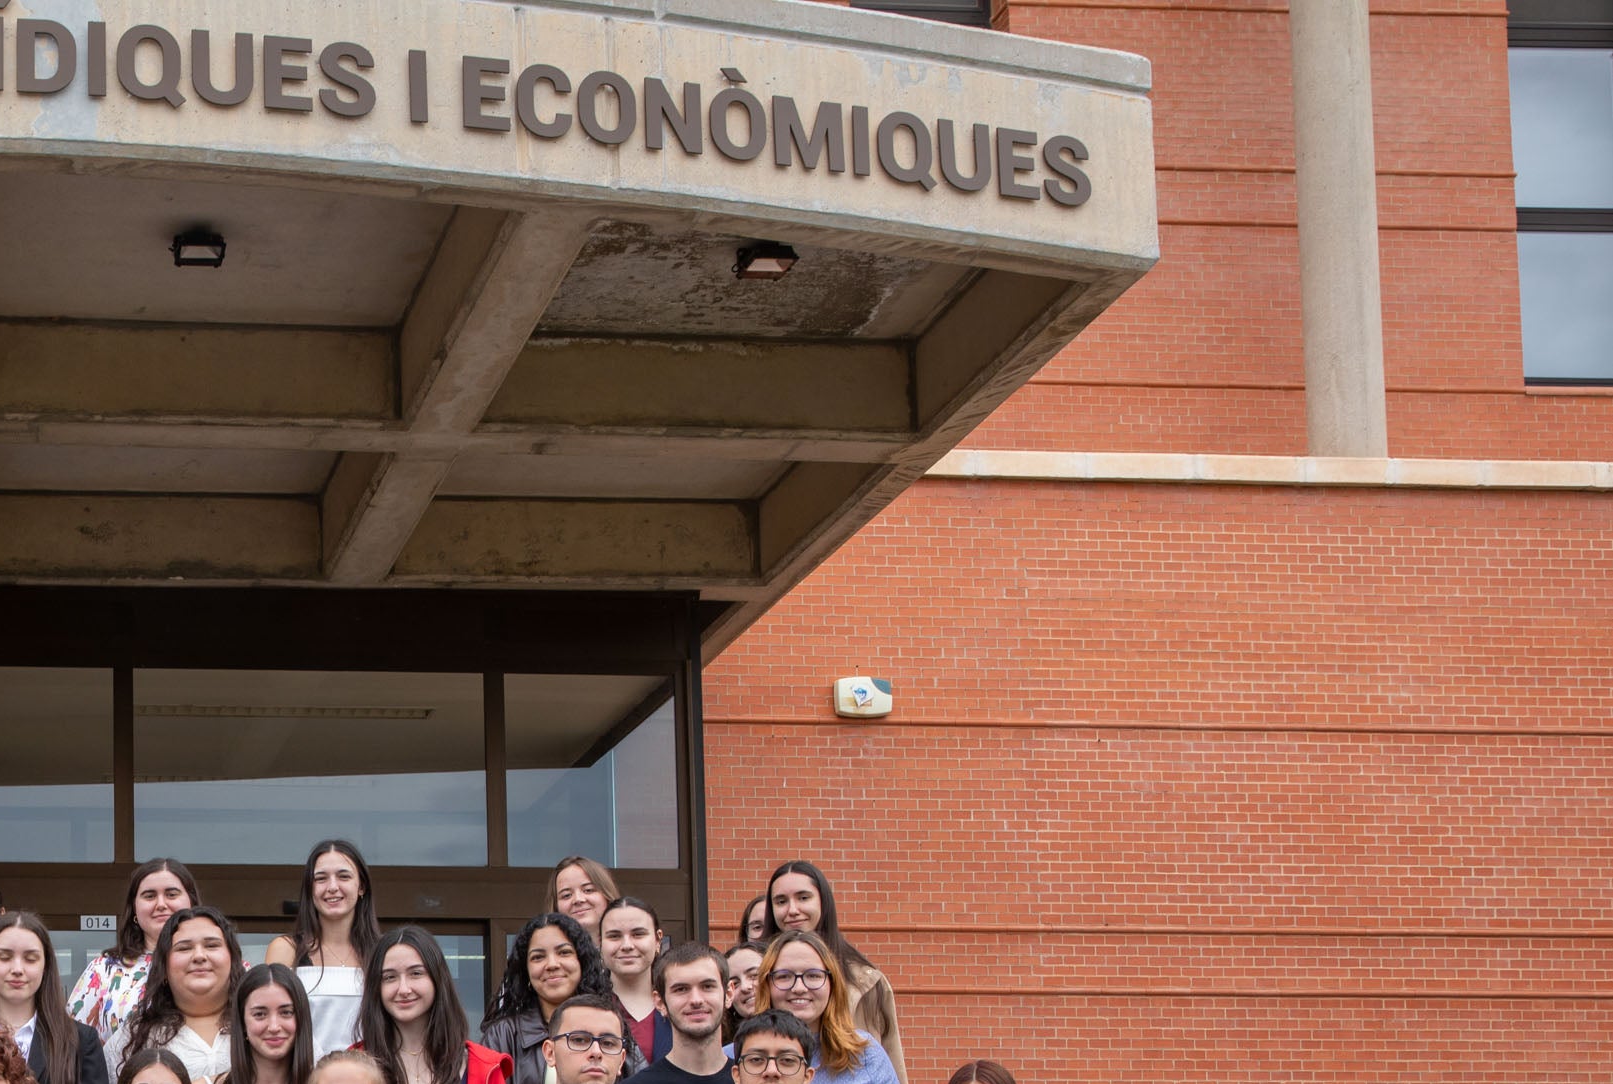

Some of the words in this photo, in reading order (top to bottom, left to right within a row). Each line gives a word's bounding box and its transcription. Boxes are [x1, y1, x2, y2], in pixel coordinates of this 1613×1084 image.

[408, 49, 428, 124] I
[462, 67, 1092, 206] ECONÒMIQUES
[86, 917, 110, 929] 014
